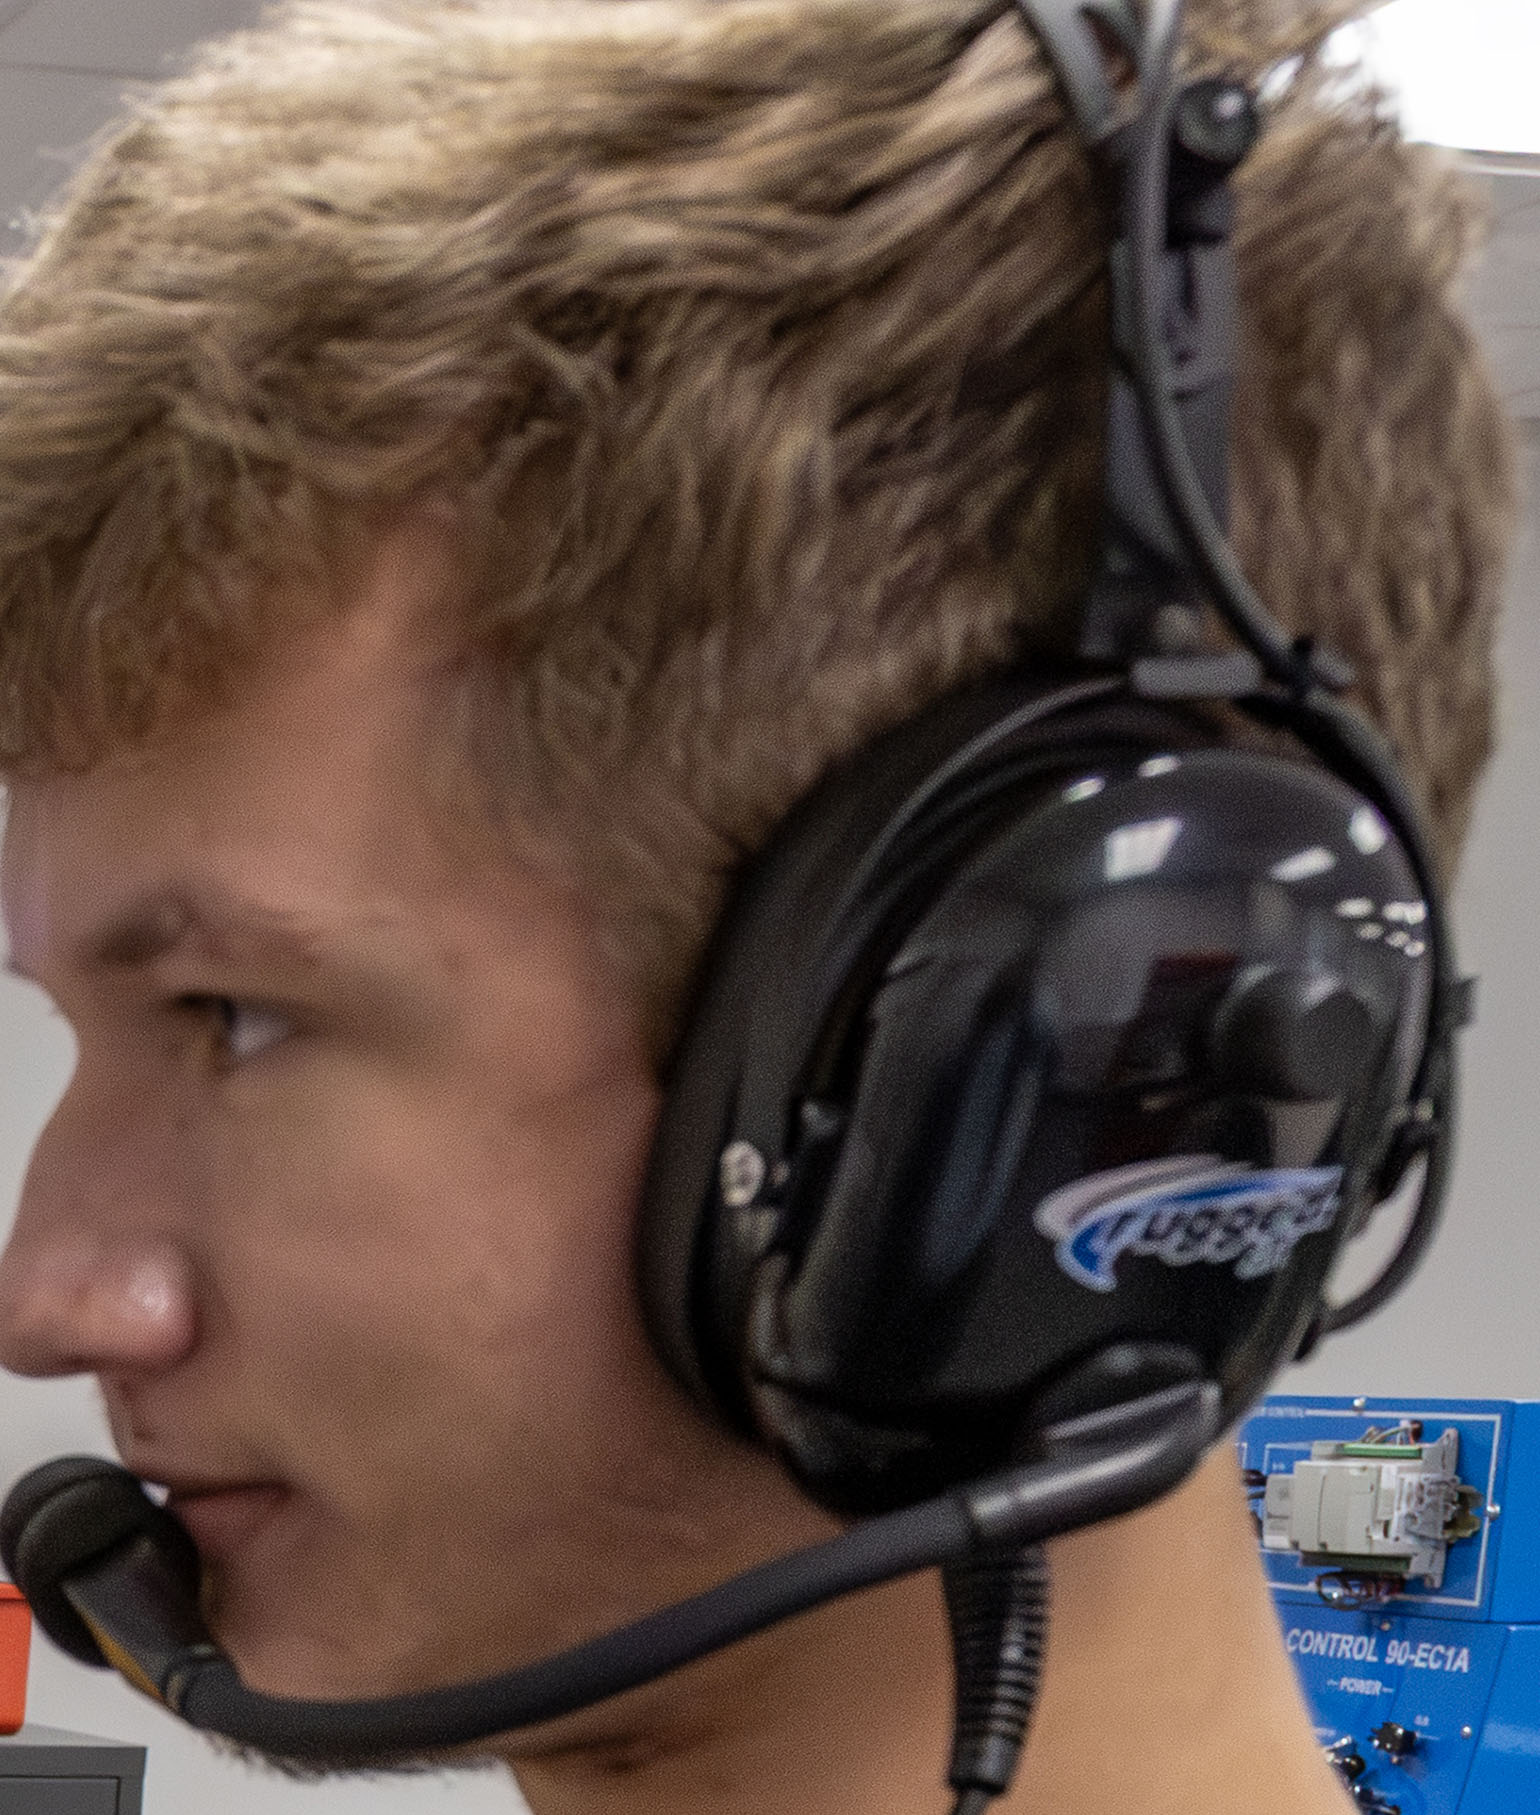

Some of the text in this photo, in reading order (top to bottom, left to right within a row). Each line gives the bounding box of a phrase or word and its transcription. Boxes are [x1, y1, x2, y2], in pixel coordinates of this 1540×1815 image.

[1287, 1627, 1470, 1673] CONTROL 90-EC1A
[1339, 1676, 1383, 1696] POWER
